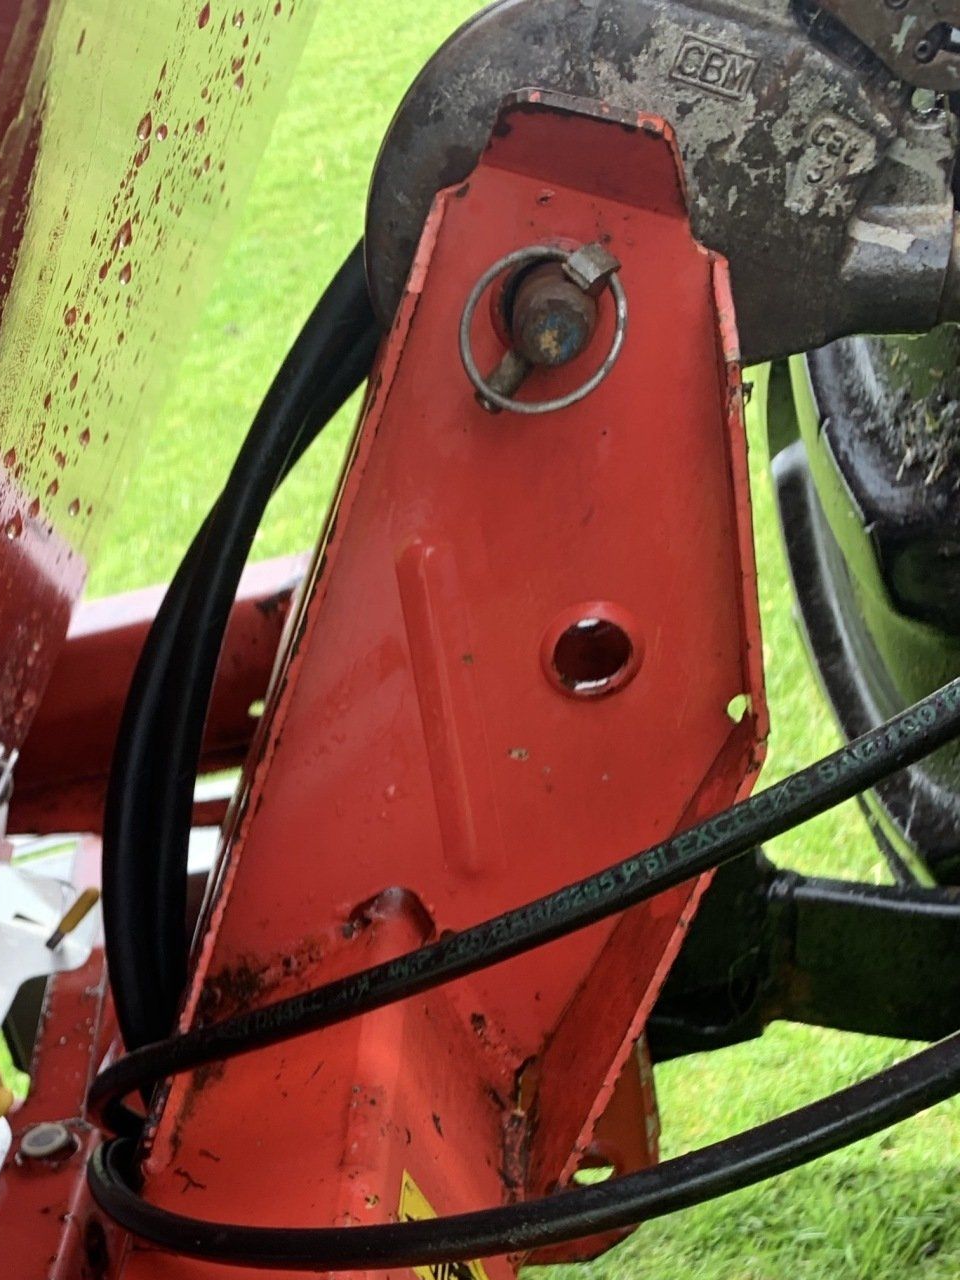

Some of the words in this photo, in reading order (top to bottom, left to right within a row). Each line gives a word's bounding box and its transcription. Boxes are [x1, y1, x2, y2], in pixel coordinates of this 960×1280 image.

[678, 44, 755, 97] CBM
[811, 121, 860, 164] Cat
[806, 158, 832, 184] 3
